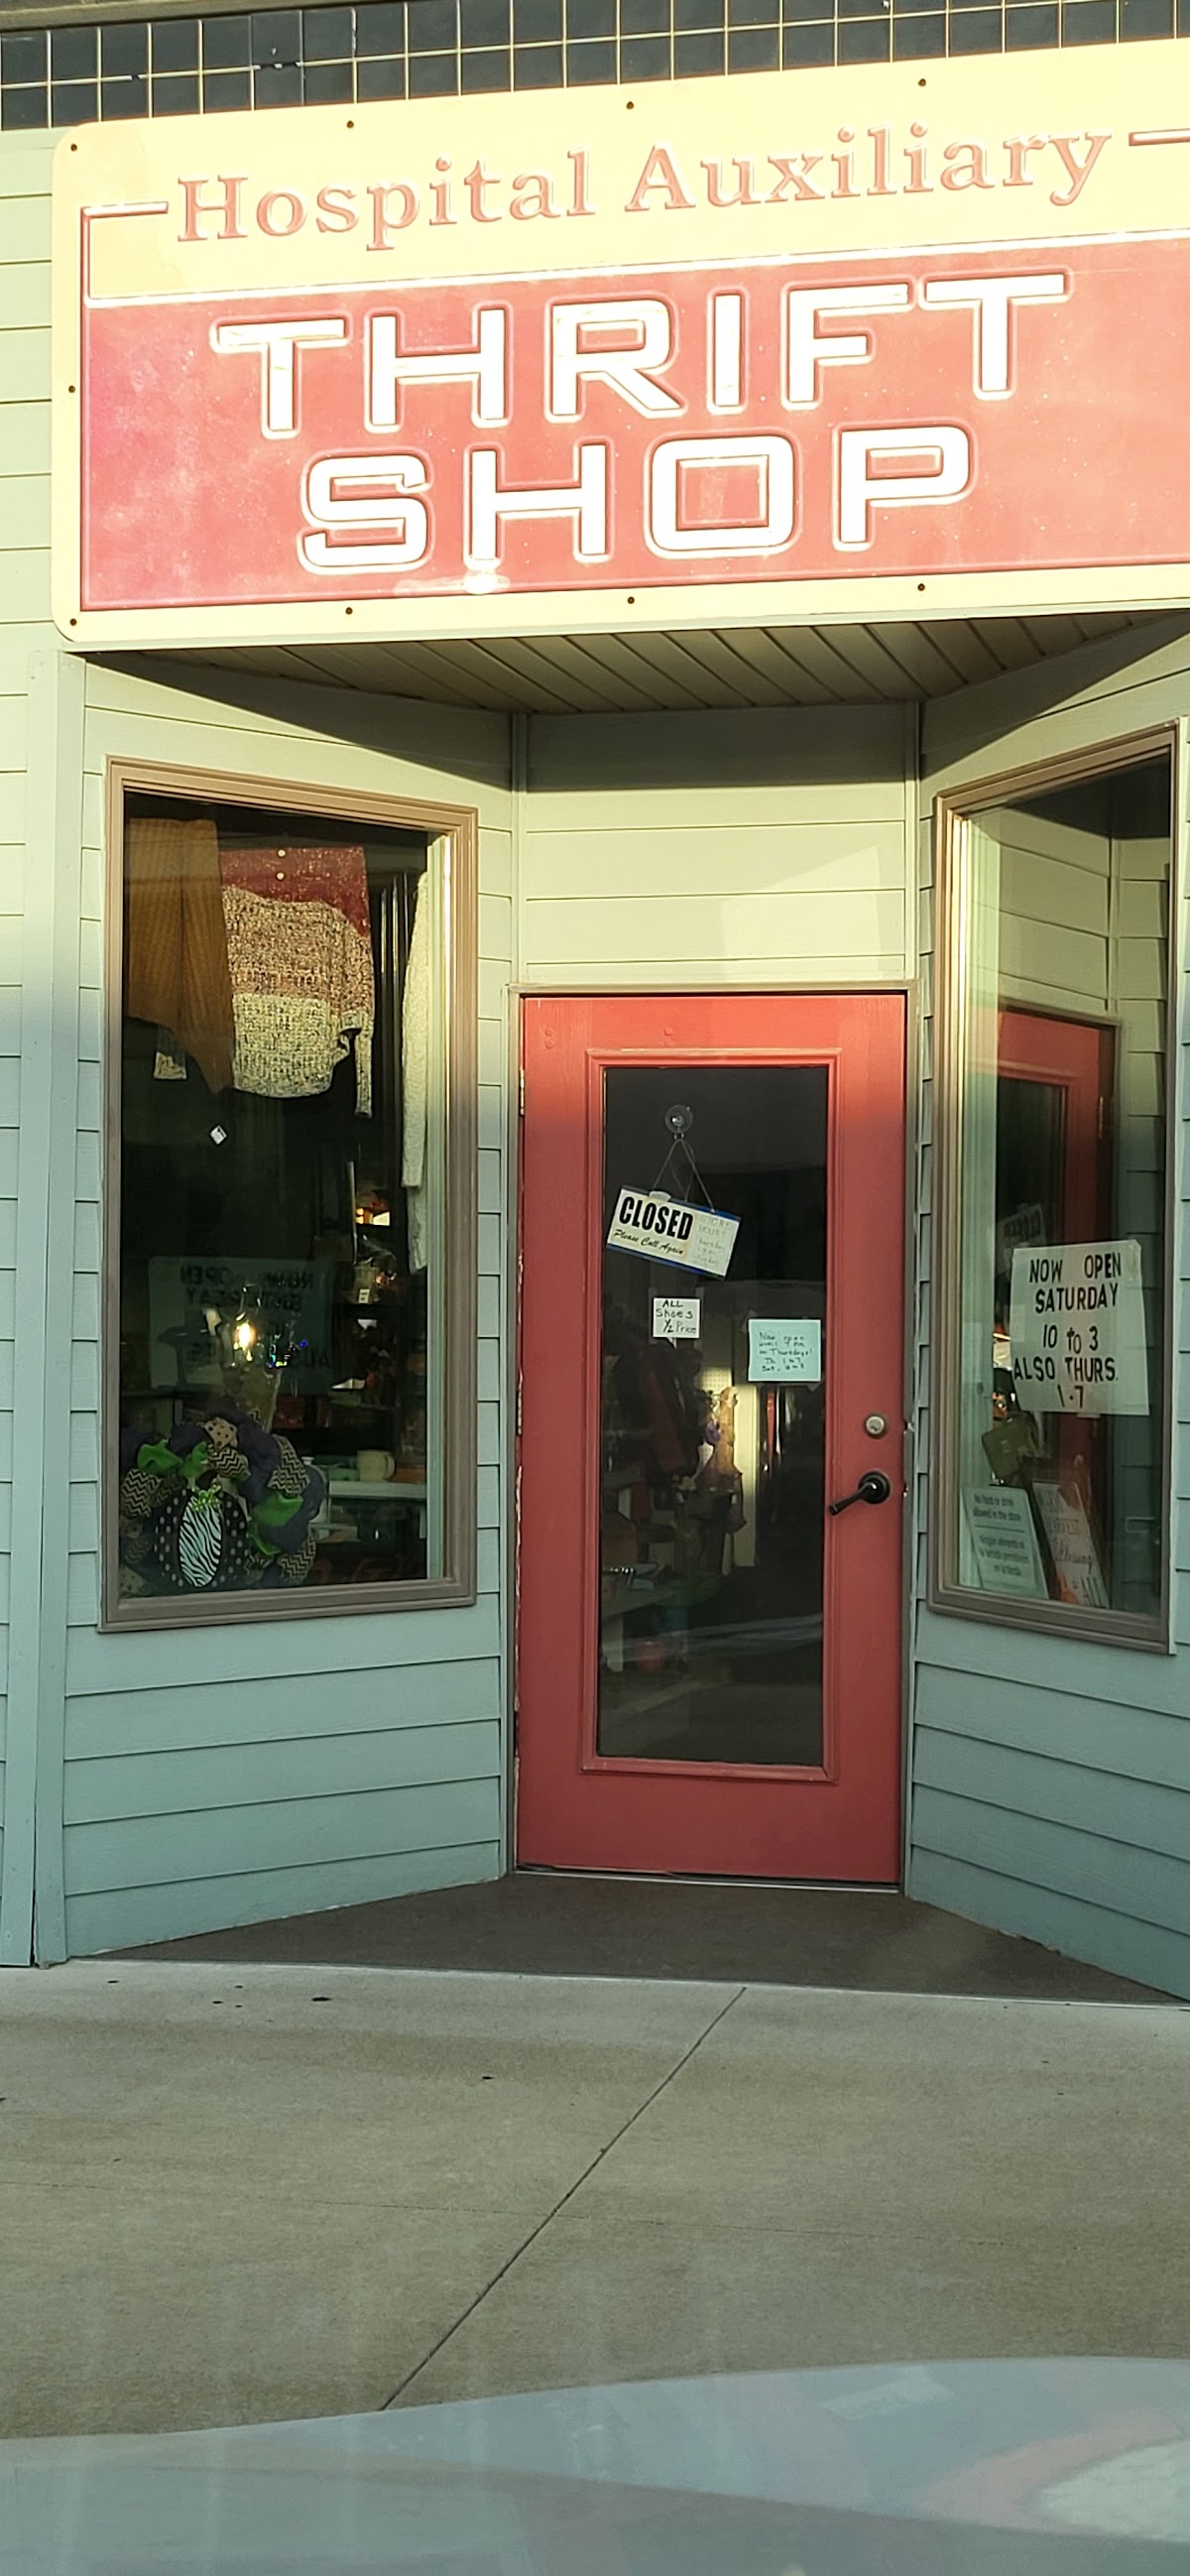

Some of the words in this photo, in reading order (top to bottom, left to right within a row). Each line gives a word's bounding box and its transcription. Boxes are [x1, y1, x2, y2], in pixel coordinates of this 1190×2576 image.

[177, 146, 595, 252] Hospital
[625, 121, 1113, 211] Auxiliary
[211, 270, 1071, 438] THRIFT
[298, 423, 976, 575] SHOP
[620, 1196, 693, 1240] CLOSED
[614, 1228, 639, 1242] Please
[641, 1237, 659, 1248] Call
[658, 1242, 683, 1255] Again
[1029, 1259, 1063, 1284] NOW
[1084, 1252, 1122, 1280] OPEN
[655, 1308, 693, 1319] Shoes
[1034, 1283, 1118, 1314] SATURDAY
[1043, 1324, 1058, 1348] 10
[1067, 1326, 1082, 1355] to
[1089, 1325, 1099, 1351] 3
[1014, 1357, 1055, 1381] ALSO
